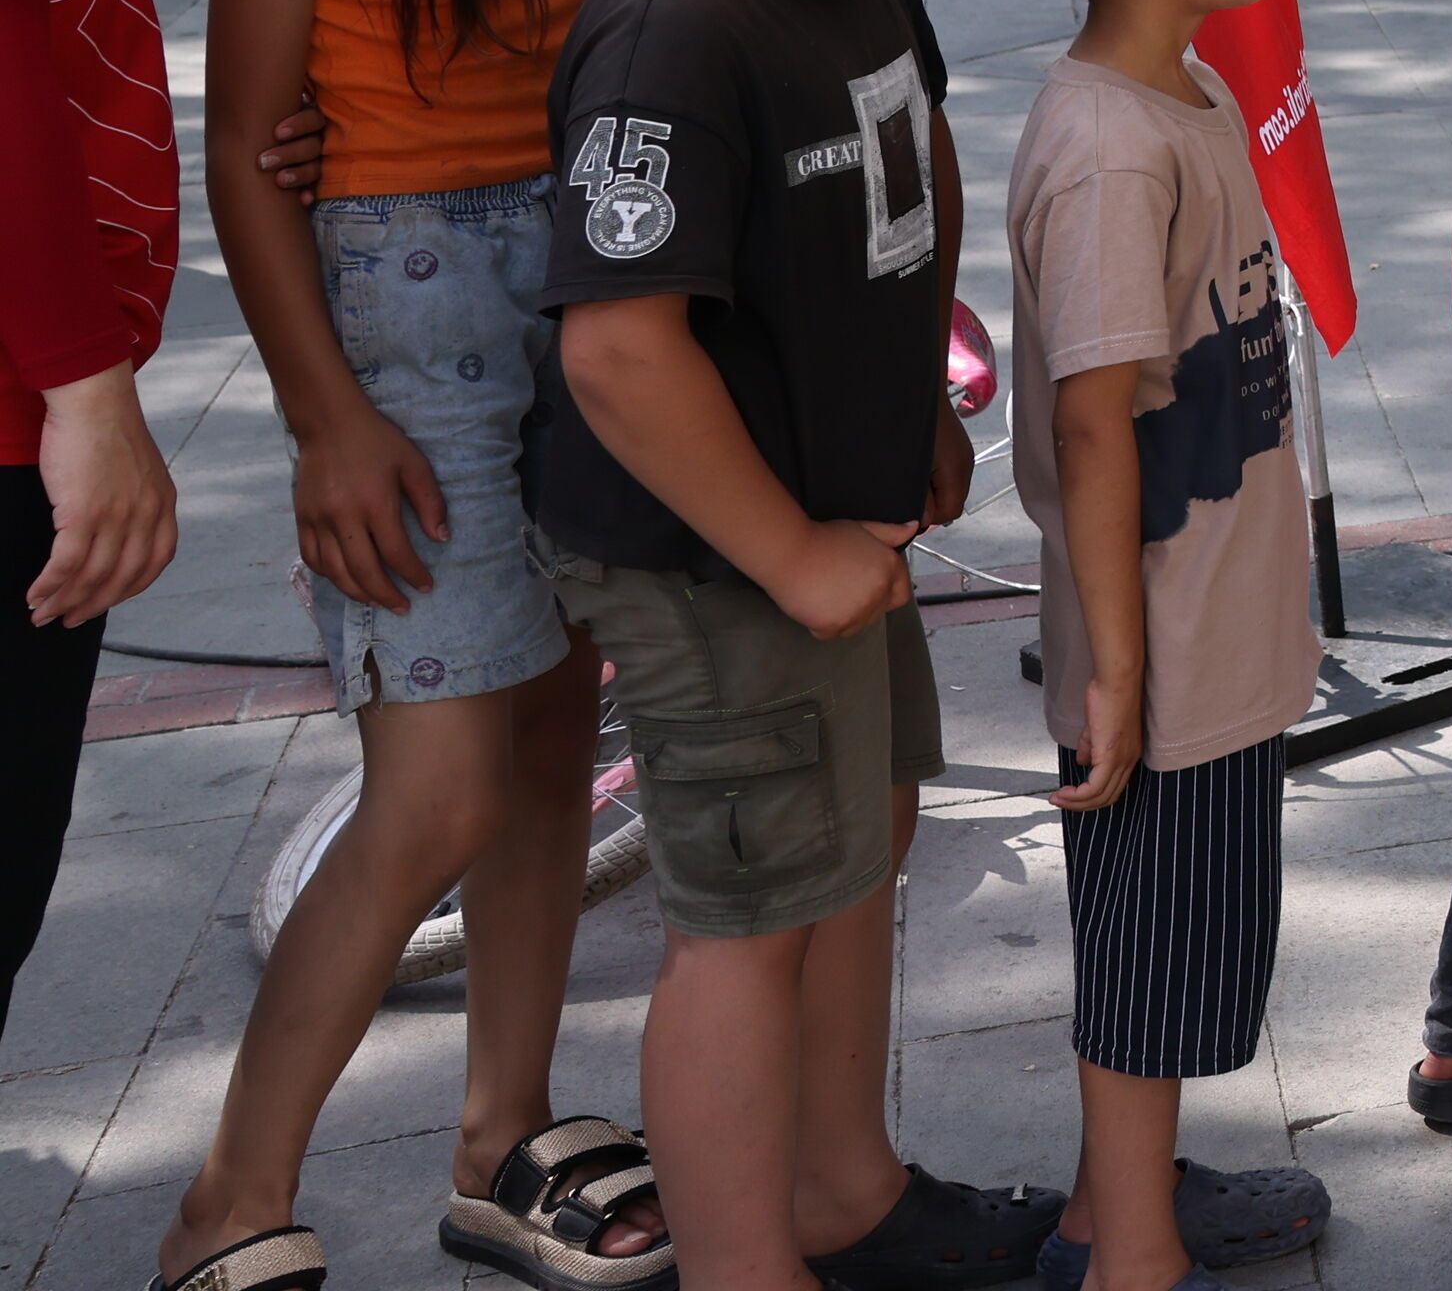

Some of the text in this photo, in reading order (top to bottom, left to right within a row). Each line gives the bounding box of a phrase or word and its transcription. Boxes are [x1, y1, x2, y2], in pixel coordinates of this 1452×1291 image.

[569, 116, 673, 201] 45
[797, 139, 862, 177] GREAT
[593, 186, 646, 220] EVERYTHING
[646, 191, 664, 207] YOU
[611, 201, 653, 243] Y
